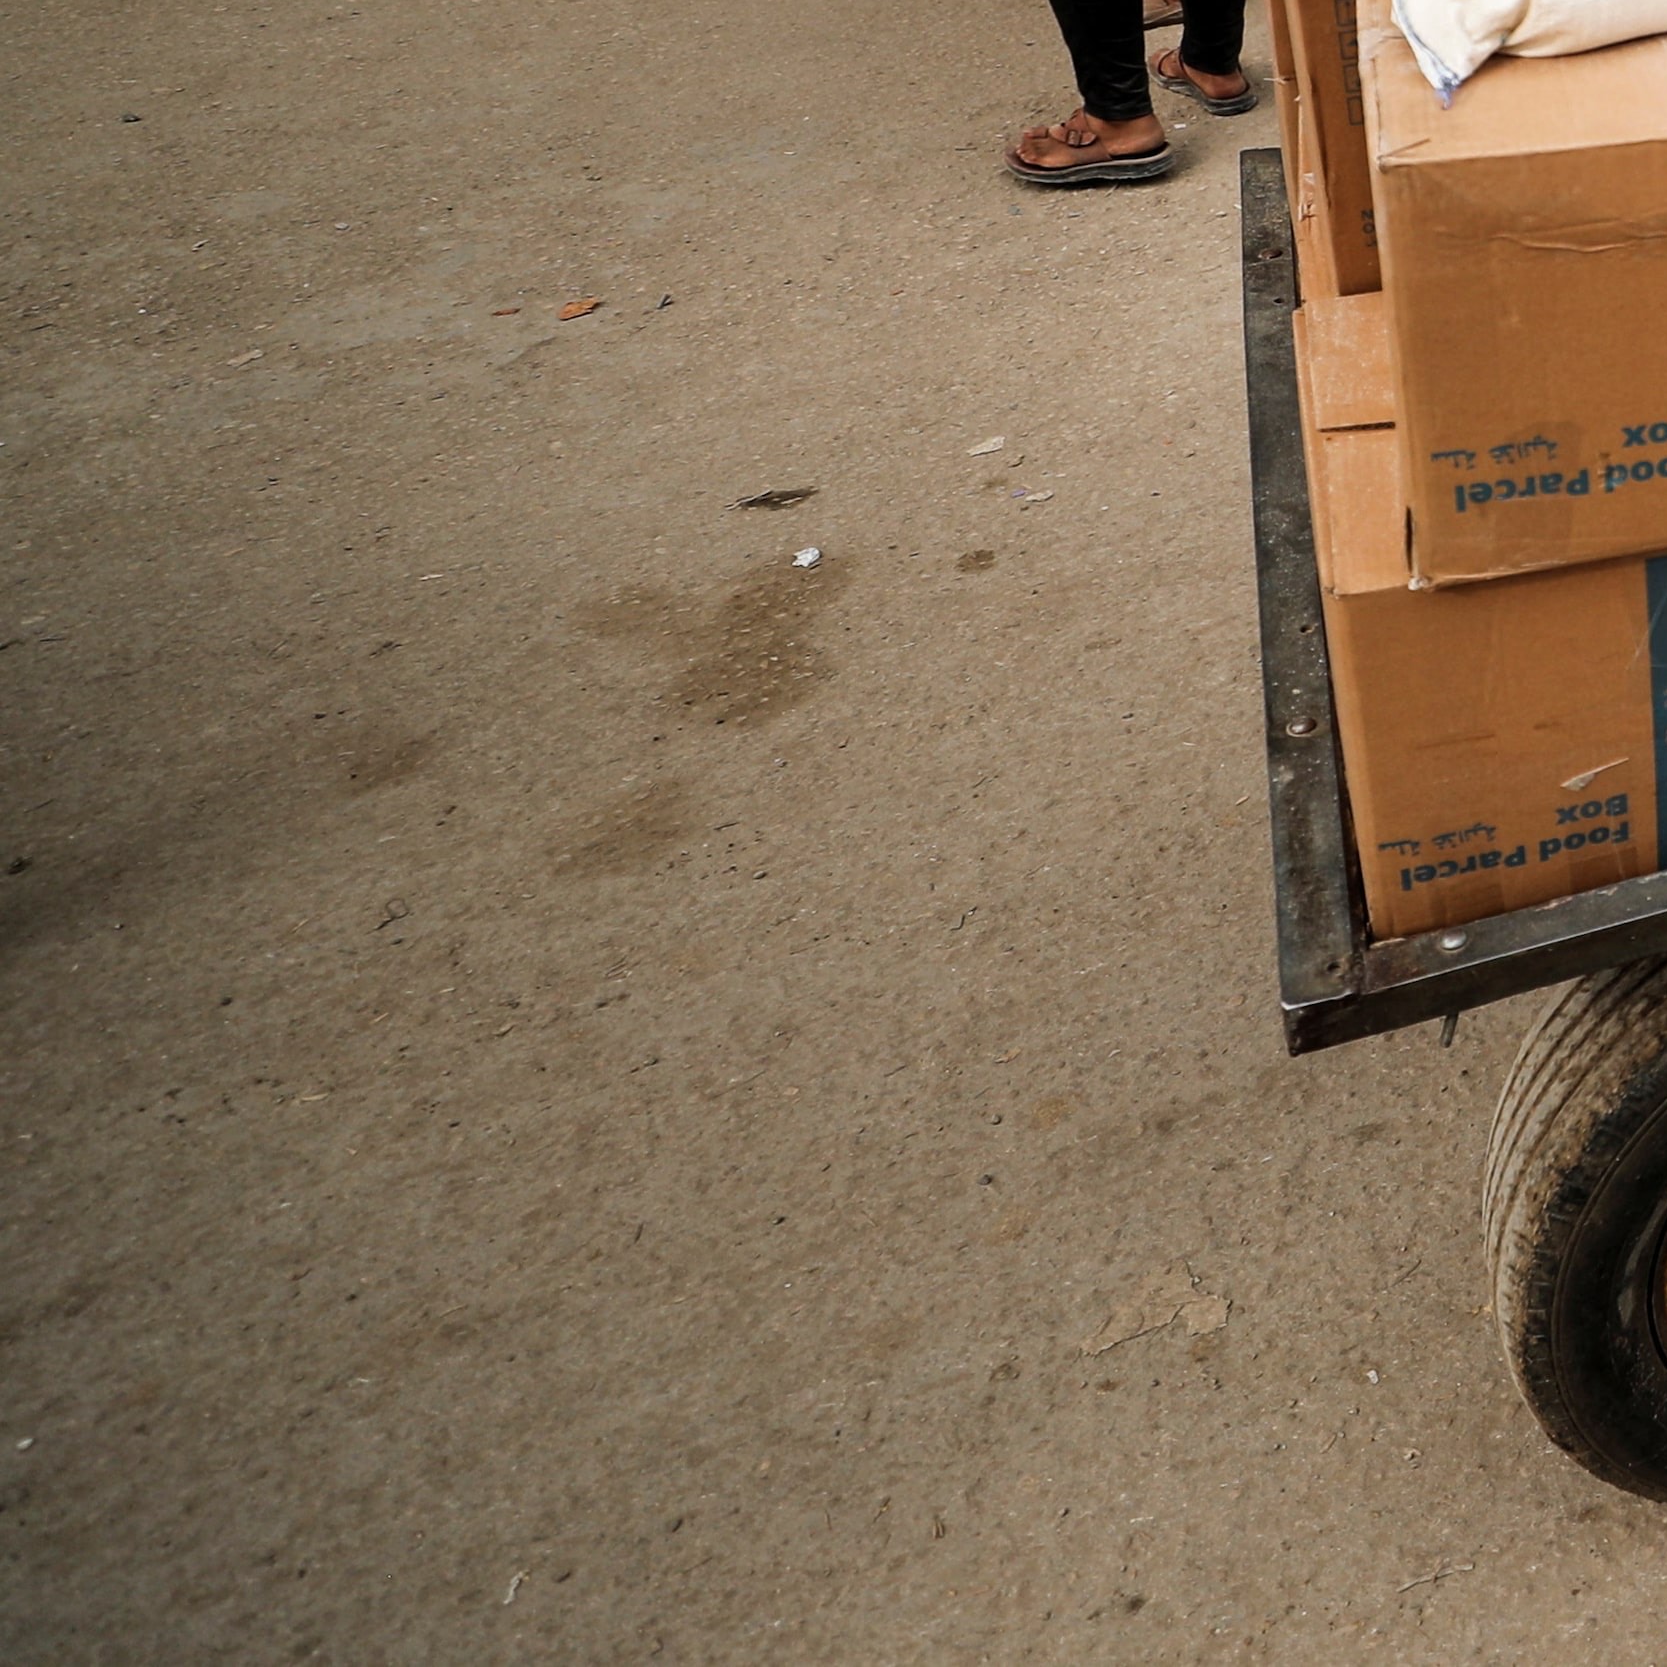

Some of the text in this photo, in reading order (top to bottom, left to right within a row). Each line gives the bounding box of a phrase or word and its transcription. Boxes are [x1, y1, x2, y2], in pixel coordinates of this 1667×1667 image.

[1454, 469, 1590, 513] Parcel
[1555, 794, 1628, 827] Box
[1400, 822, 1630, 891] Food Parcel
